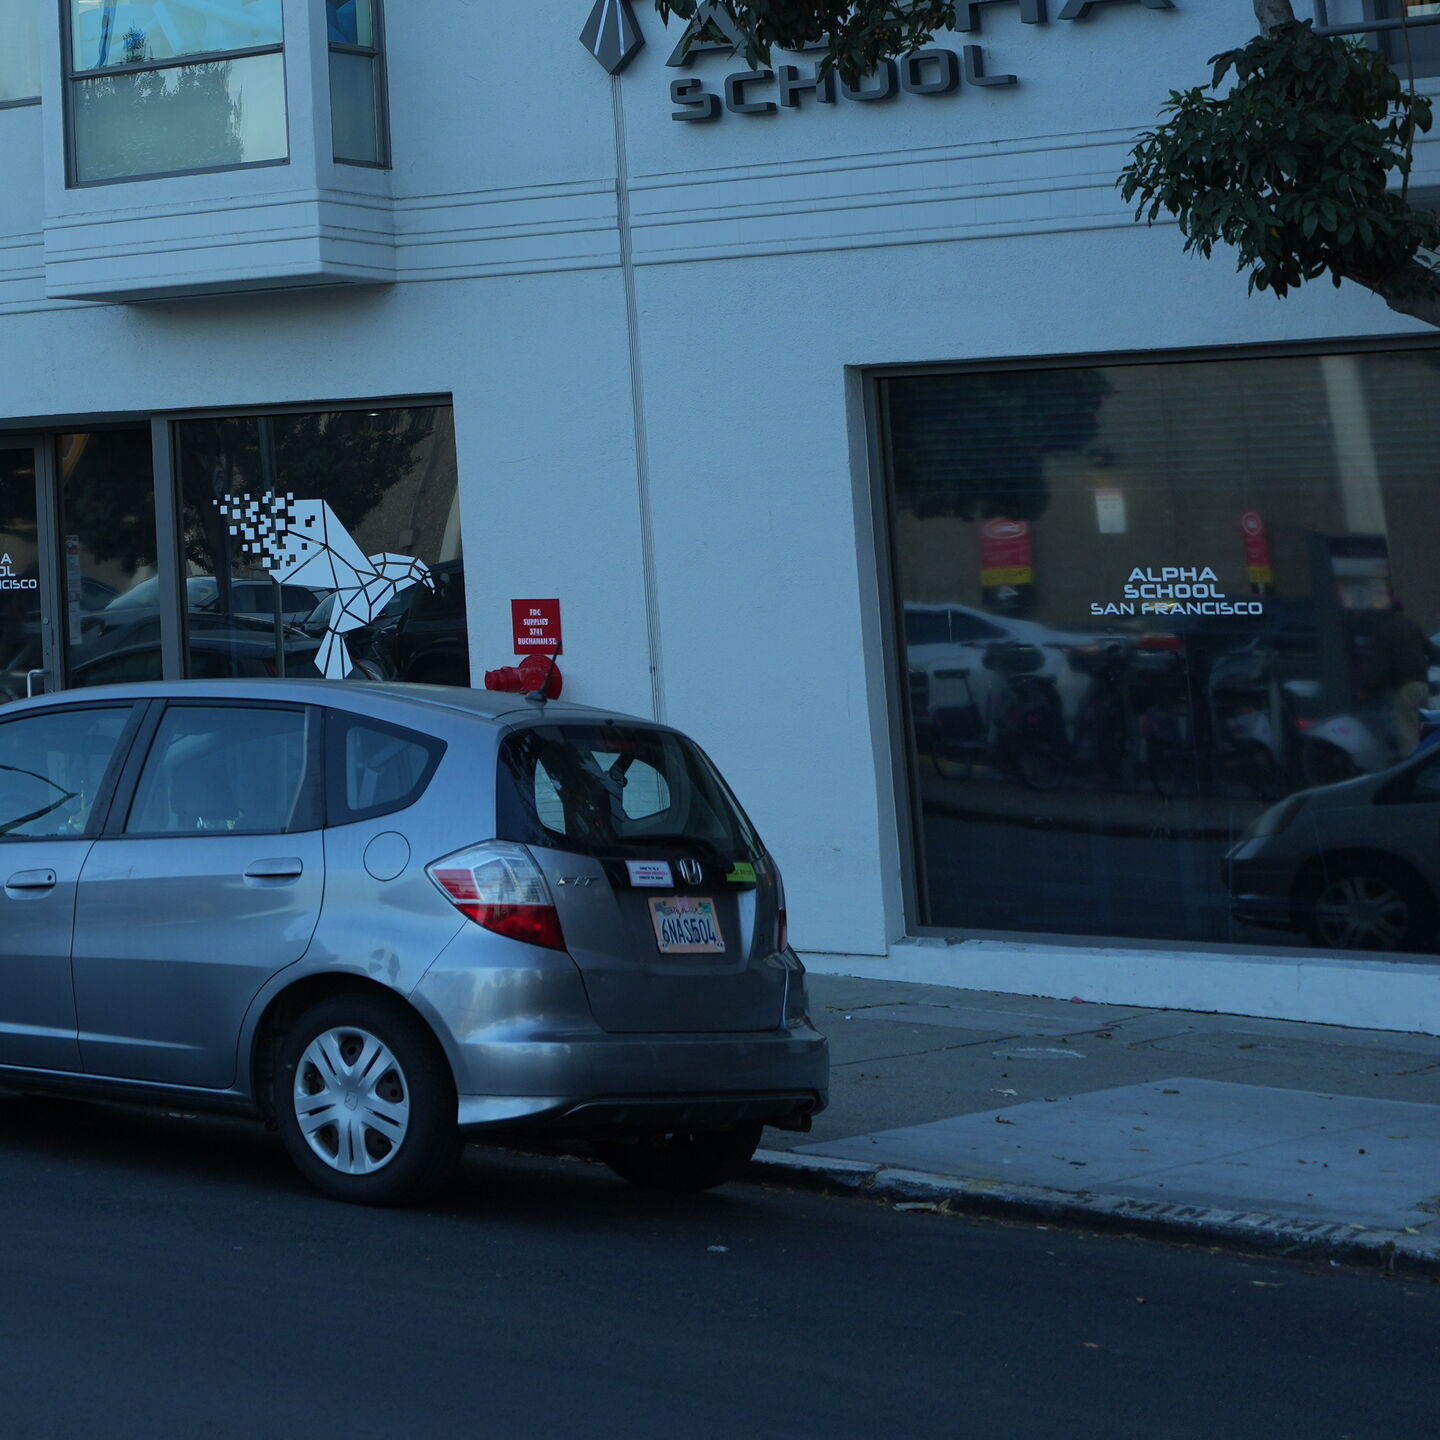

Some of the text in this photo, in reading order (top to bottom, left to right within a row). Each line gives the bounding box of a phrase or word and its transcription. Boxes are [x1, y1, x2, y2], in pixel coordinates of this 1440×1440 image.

[670, 44, 1019, 123] SCHOOL
[1127, 566, 1218, 582] ALPHA
[1124, 583, 1225, 598] SCHOOL
[1090, 602, 1263, 615] SAN FRANCISCO
[529, 628, 543, 636] 3741
[517, 637, 548, 645] BUCHANAN
[662, 918, 717, 944] 6NAS504
